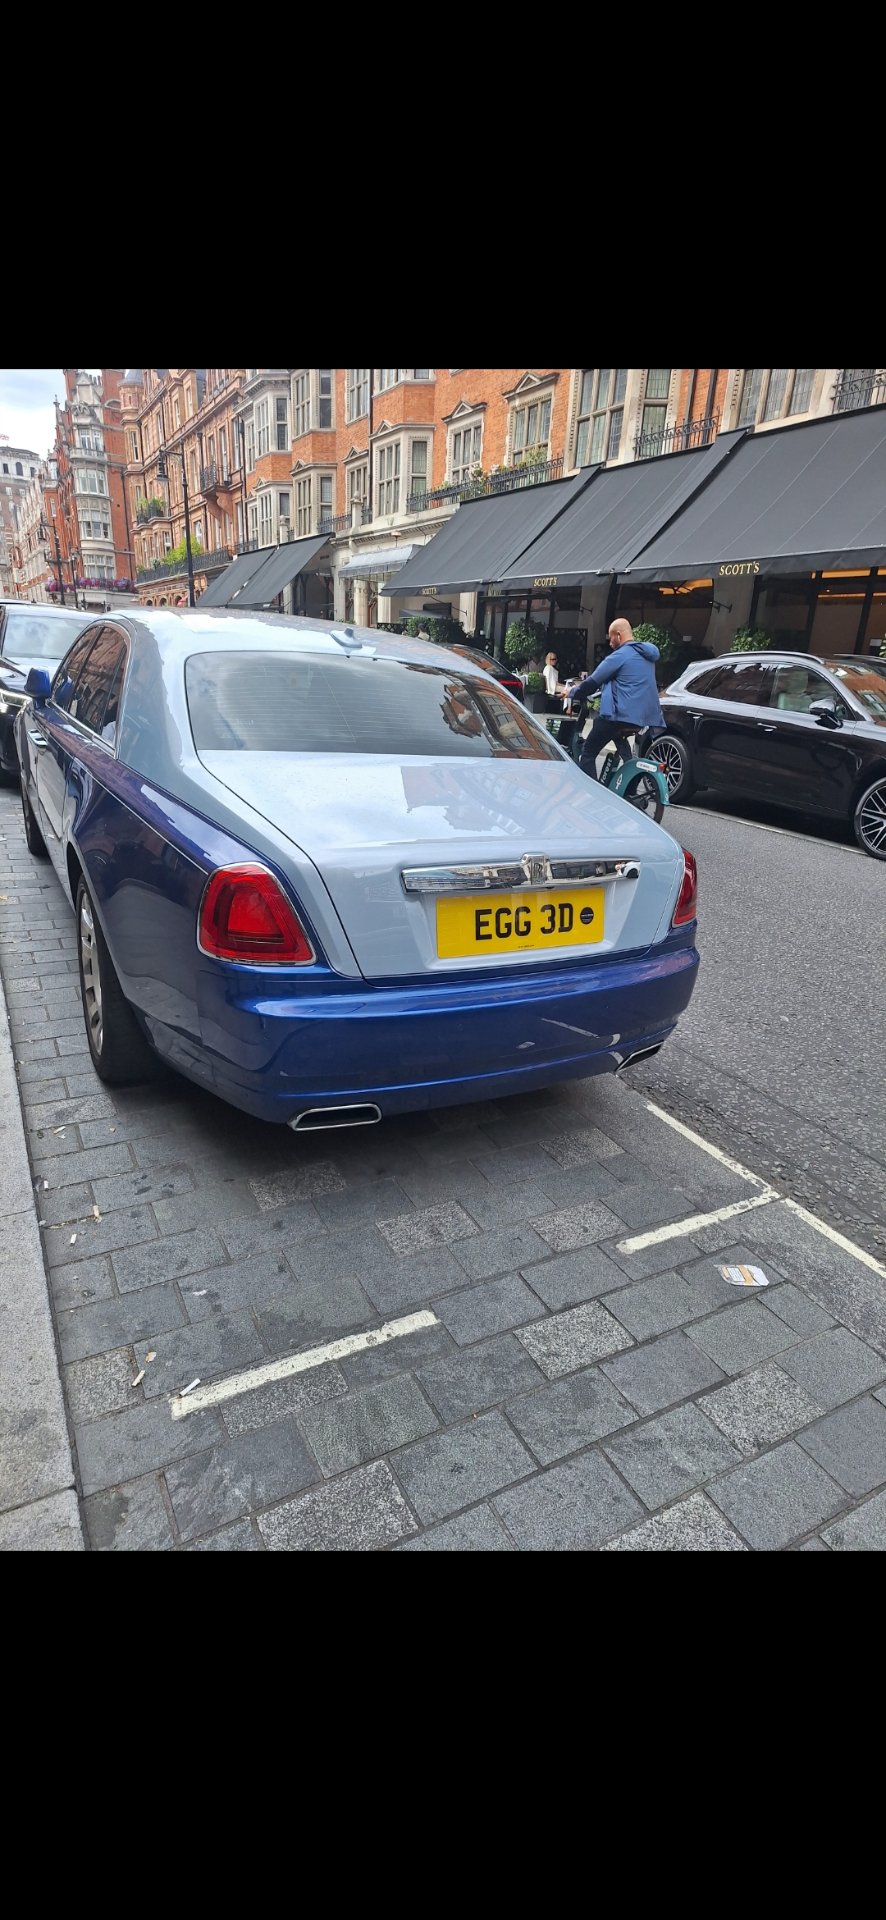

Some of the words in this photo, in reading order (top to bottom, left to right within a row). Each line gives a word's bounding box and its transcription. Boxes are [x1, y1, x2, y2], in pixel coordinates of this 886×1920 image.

[718, 560, 760, 576] SCOTT'S
[533, 576, 557, 588] SCOTT'S
[475, 905, 531, 941] EGG
[540, 902, 574, 935] 3D
